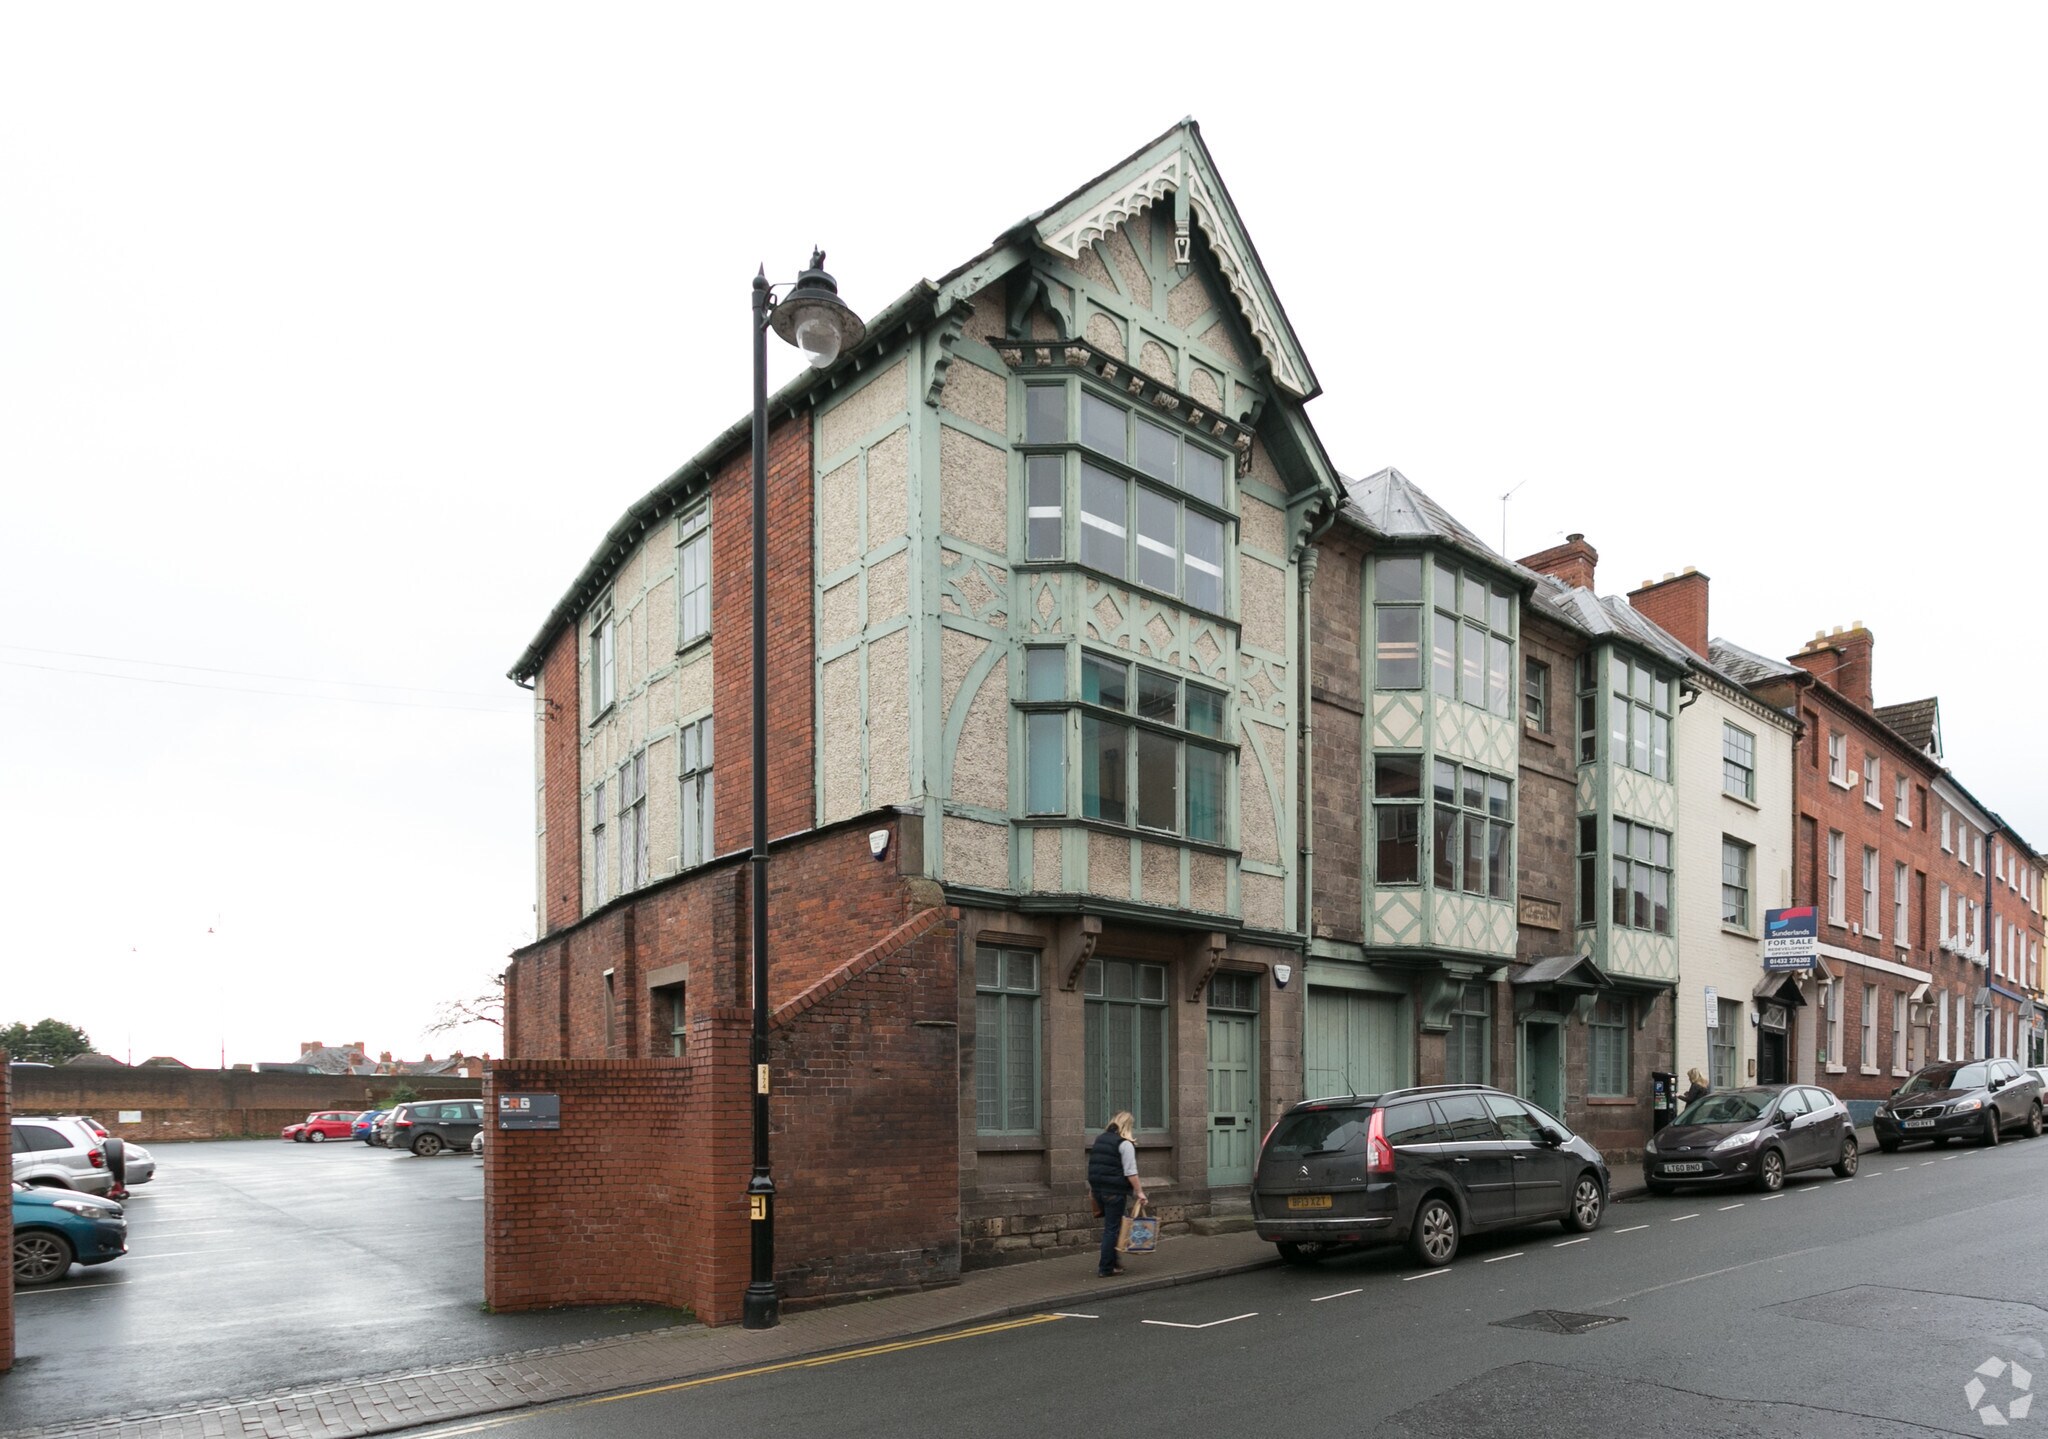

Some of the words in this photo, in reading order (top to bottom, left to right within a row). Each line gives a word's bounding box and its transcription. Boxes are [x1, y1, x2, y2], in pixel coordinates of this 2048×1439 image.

[500, 1098, 530, 1108] CRG
[1667, 1164, 1685, 1172] LT60
[1686, 1163, 1700, 1171] BNO
